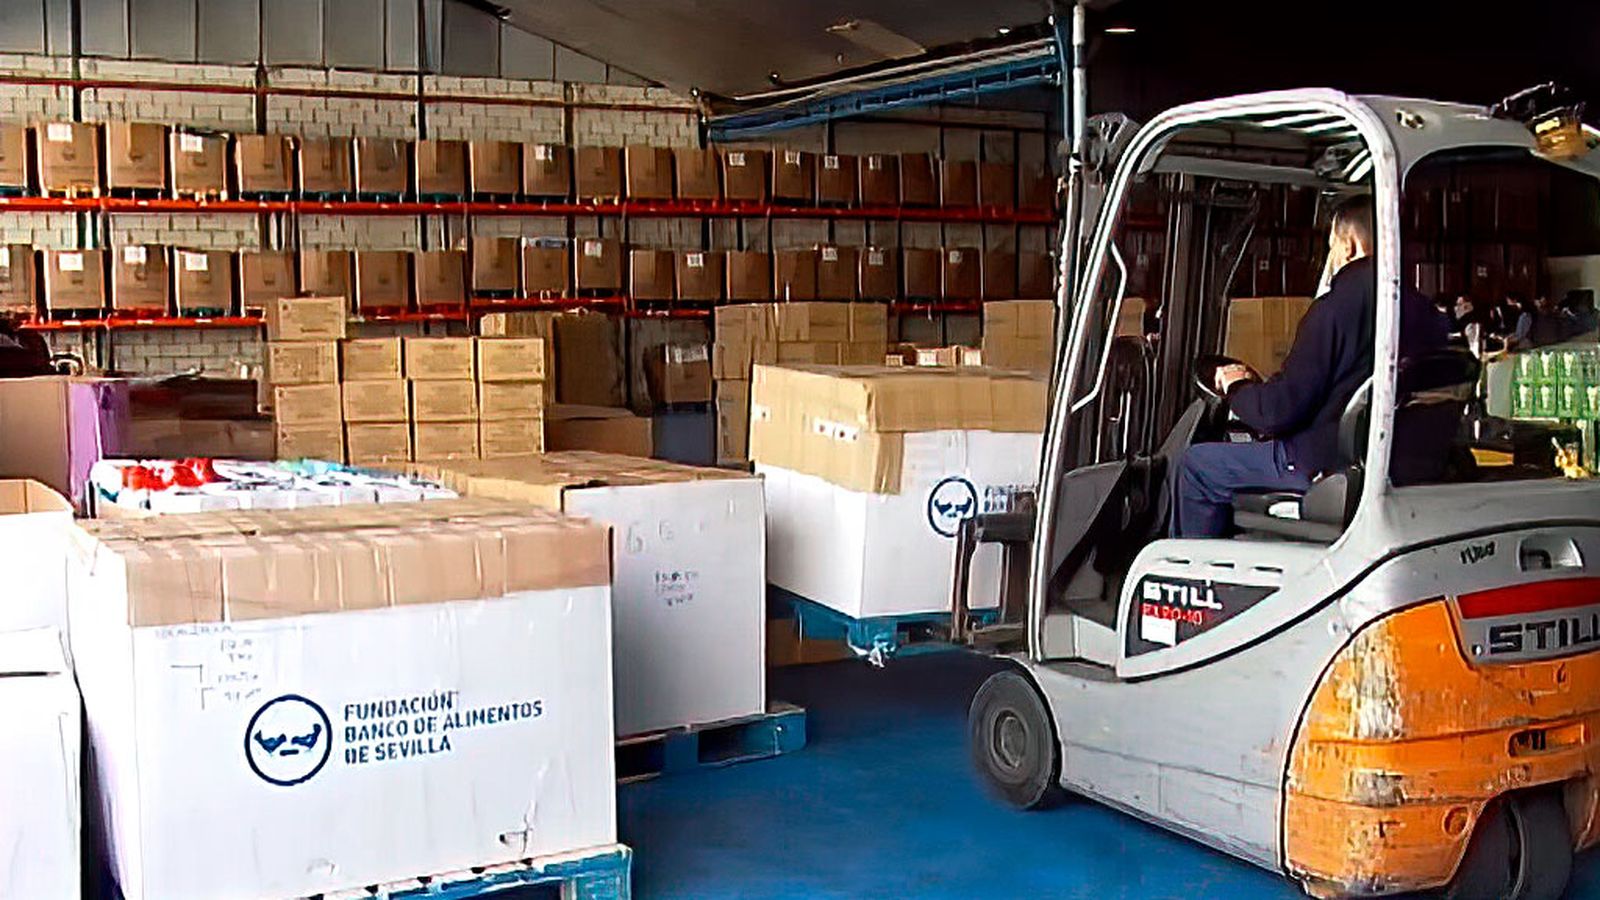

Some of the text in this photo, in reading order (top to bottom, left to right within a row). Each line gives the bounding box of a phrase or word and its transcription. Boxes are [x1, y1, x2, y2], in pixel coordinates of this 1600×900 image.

[1143, 581, 1223, 610] STILL
[1489, 613, 1600, 655] STILL
[344, 690, 454, 722] FUNDACIÓN
[344, 700, 543, 744] BANCO DE ALIMENTOS
[344, 735, 452, 765] DE SEVILLA
